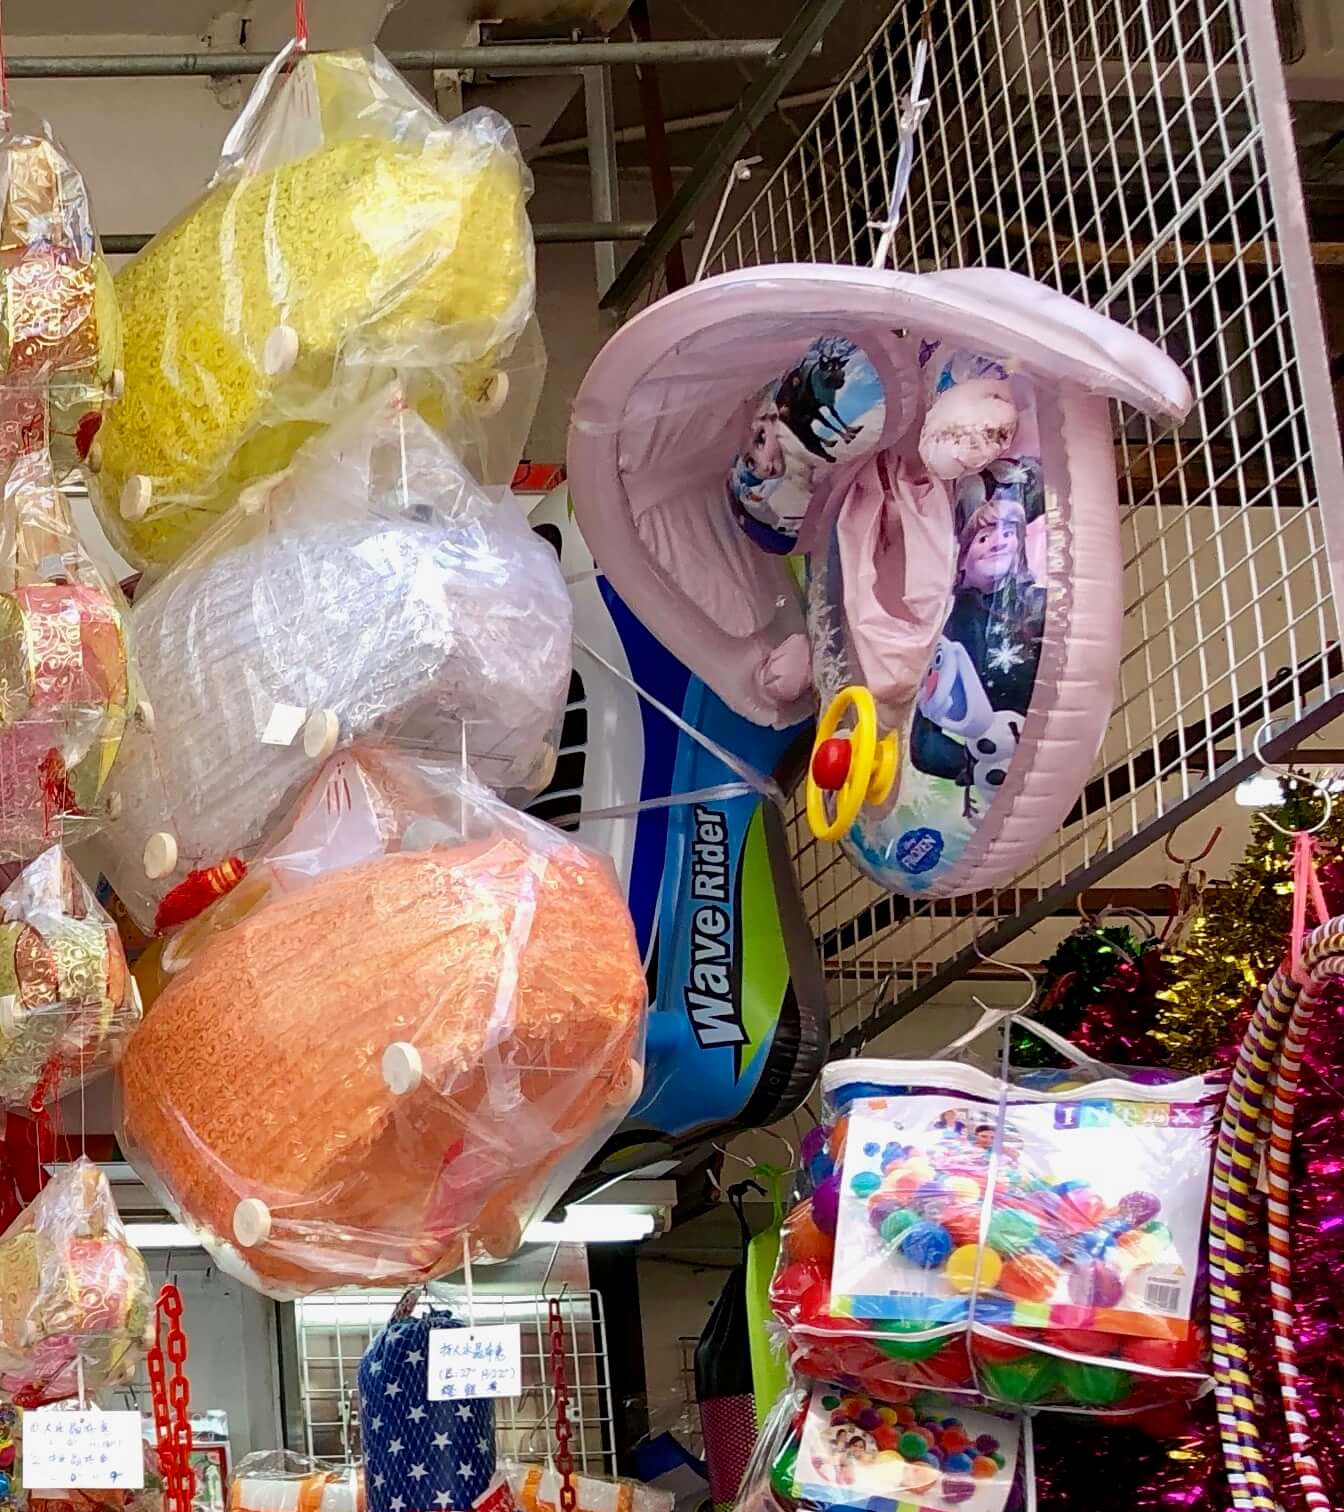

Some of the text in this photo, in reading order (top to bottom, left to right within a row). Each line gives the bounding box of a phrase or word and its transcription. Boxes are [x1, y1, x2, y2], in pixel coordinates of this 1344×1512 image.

[692, 806, 726, 901] Rider
[687, 908, 747, 1046] Wave
[1062, 1105, 1195, 1127] INTEX
